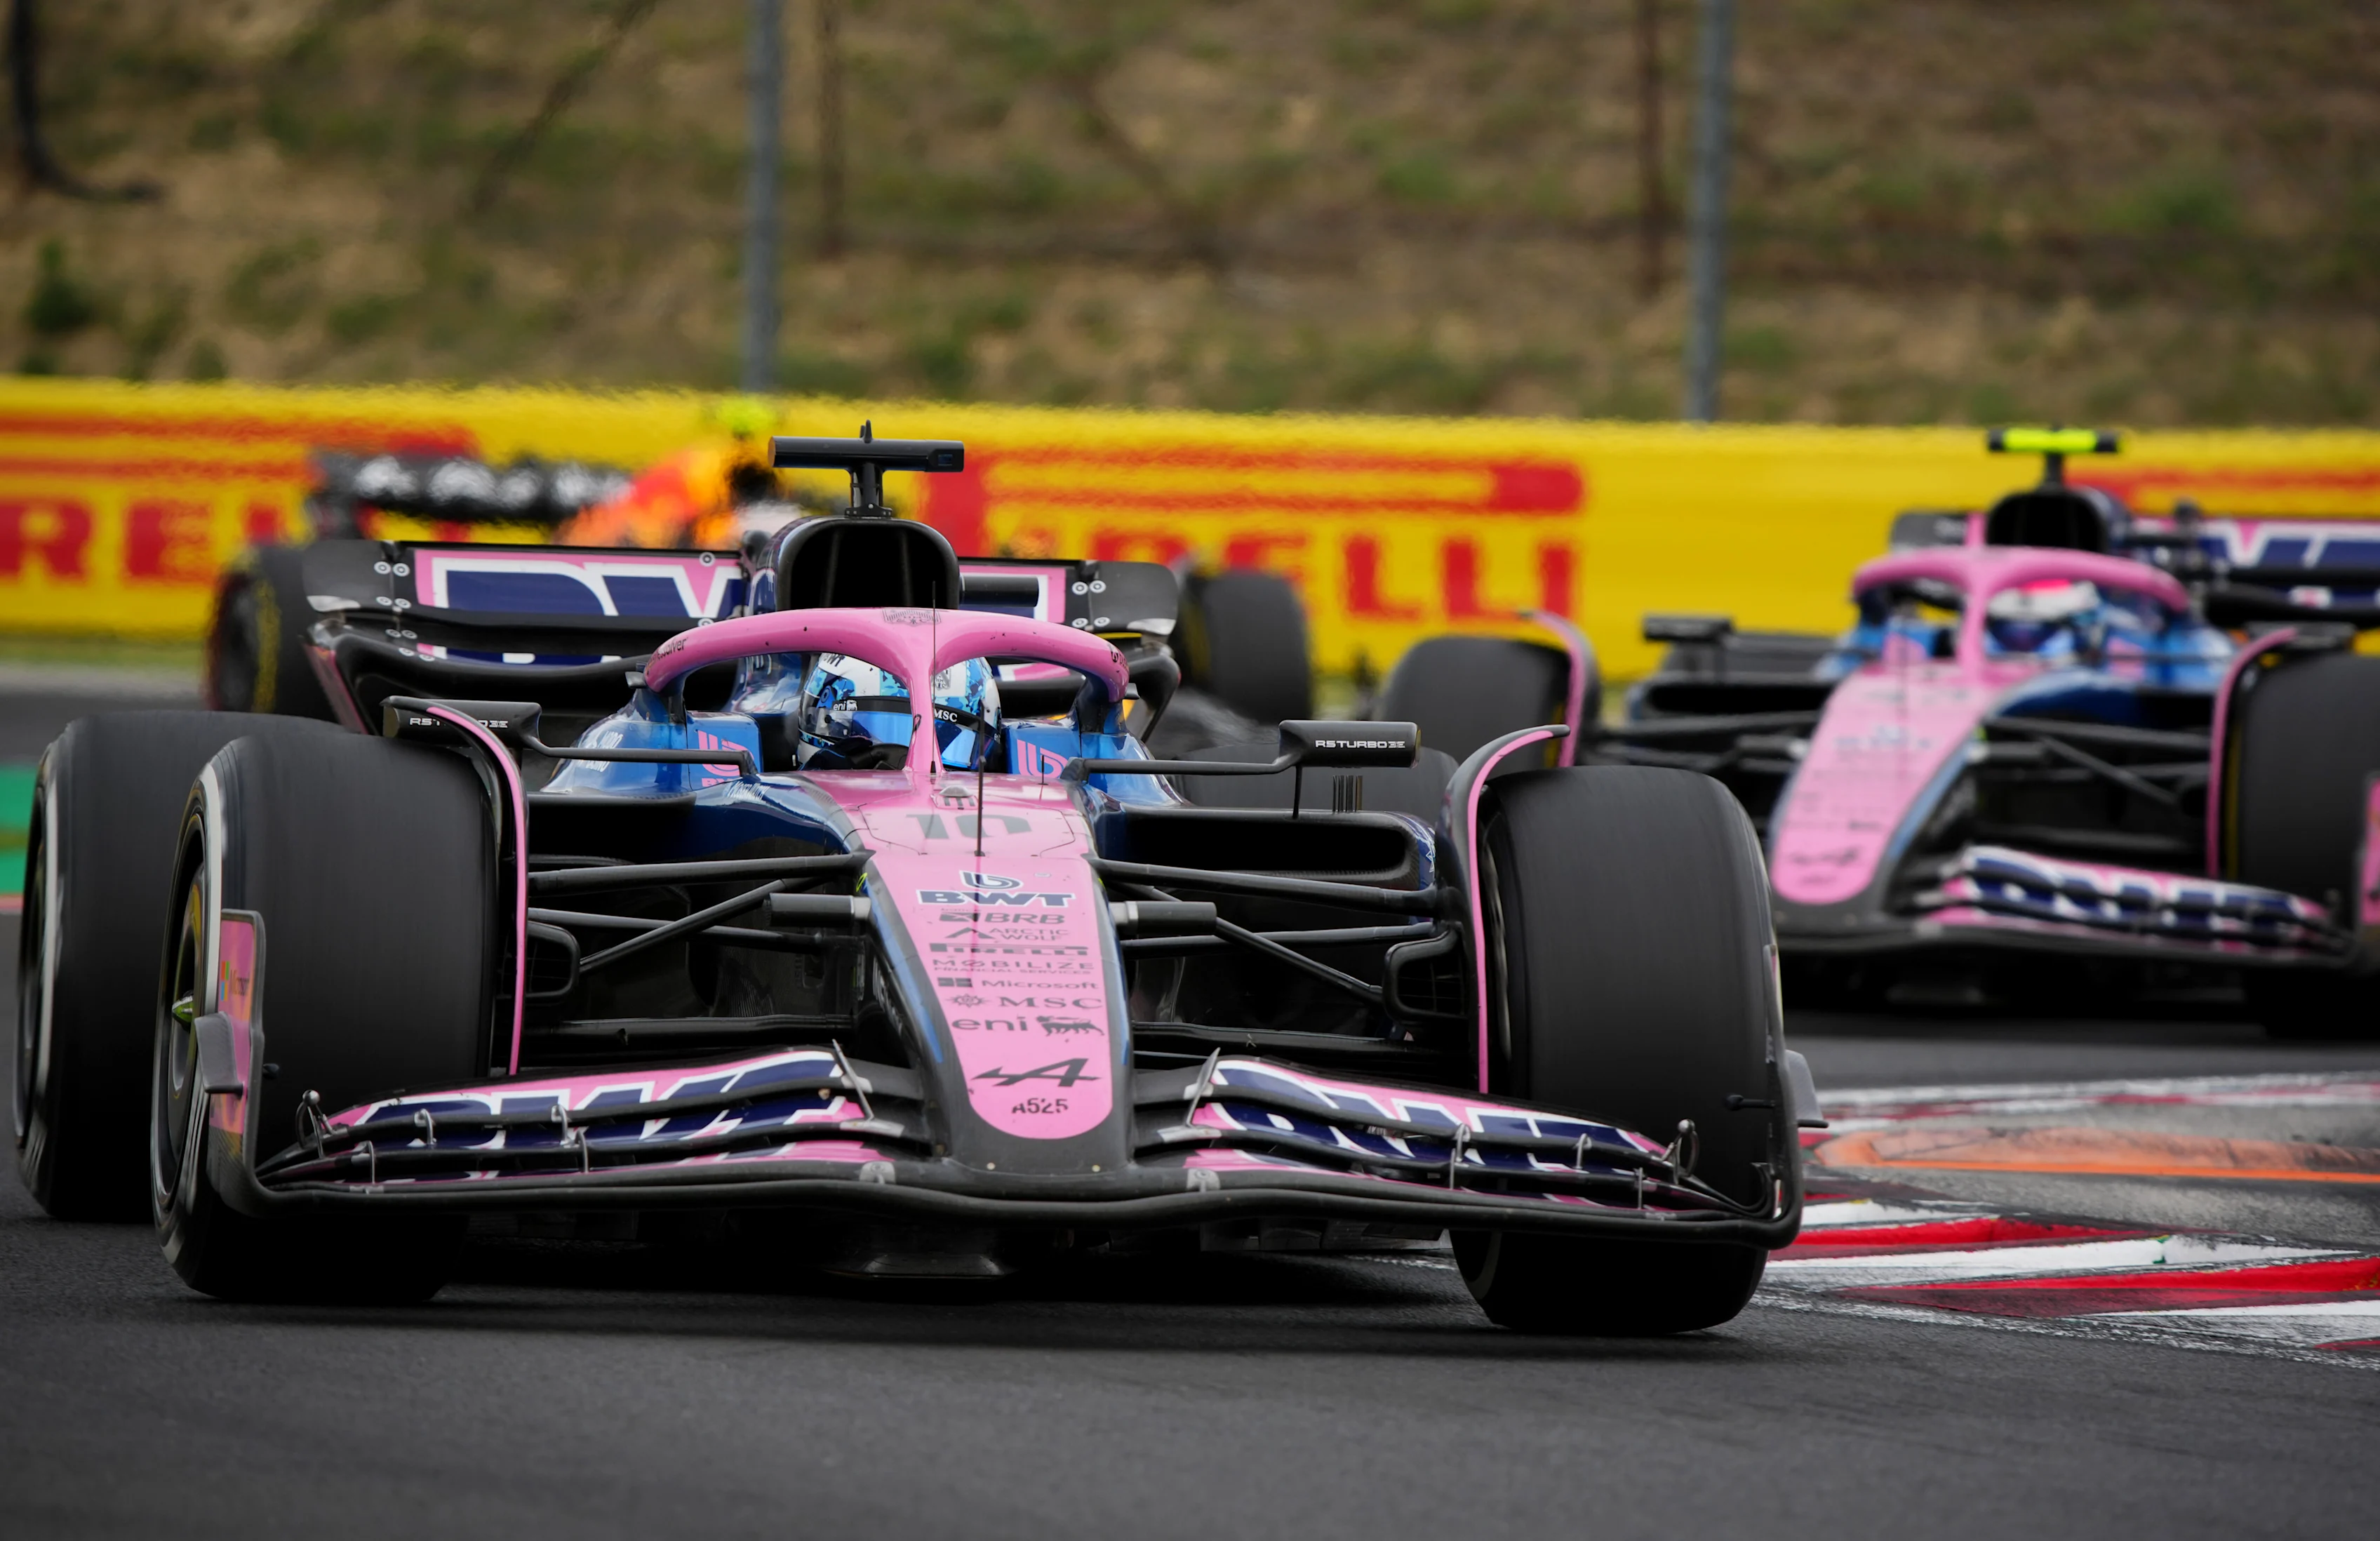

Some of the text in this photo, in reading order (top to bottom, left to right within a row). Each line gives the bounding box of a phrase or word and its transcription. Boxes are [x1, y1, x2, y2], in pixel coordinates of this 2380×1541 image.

[934, 709, 958, 723] MSC
[906, 813, 1033, 840] 10
[916, 889, 1076, 908] BWT
[984, 912, 1065, 924] BRB
[982, 980, 1099, 989] Microsoft
[998, 996, 1103, 1009] MSC
[951, 1016, 1029, 1032] eni
[1012, 1098, 1069, 1114] A525
